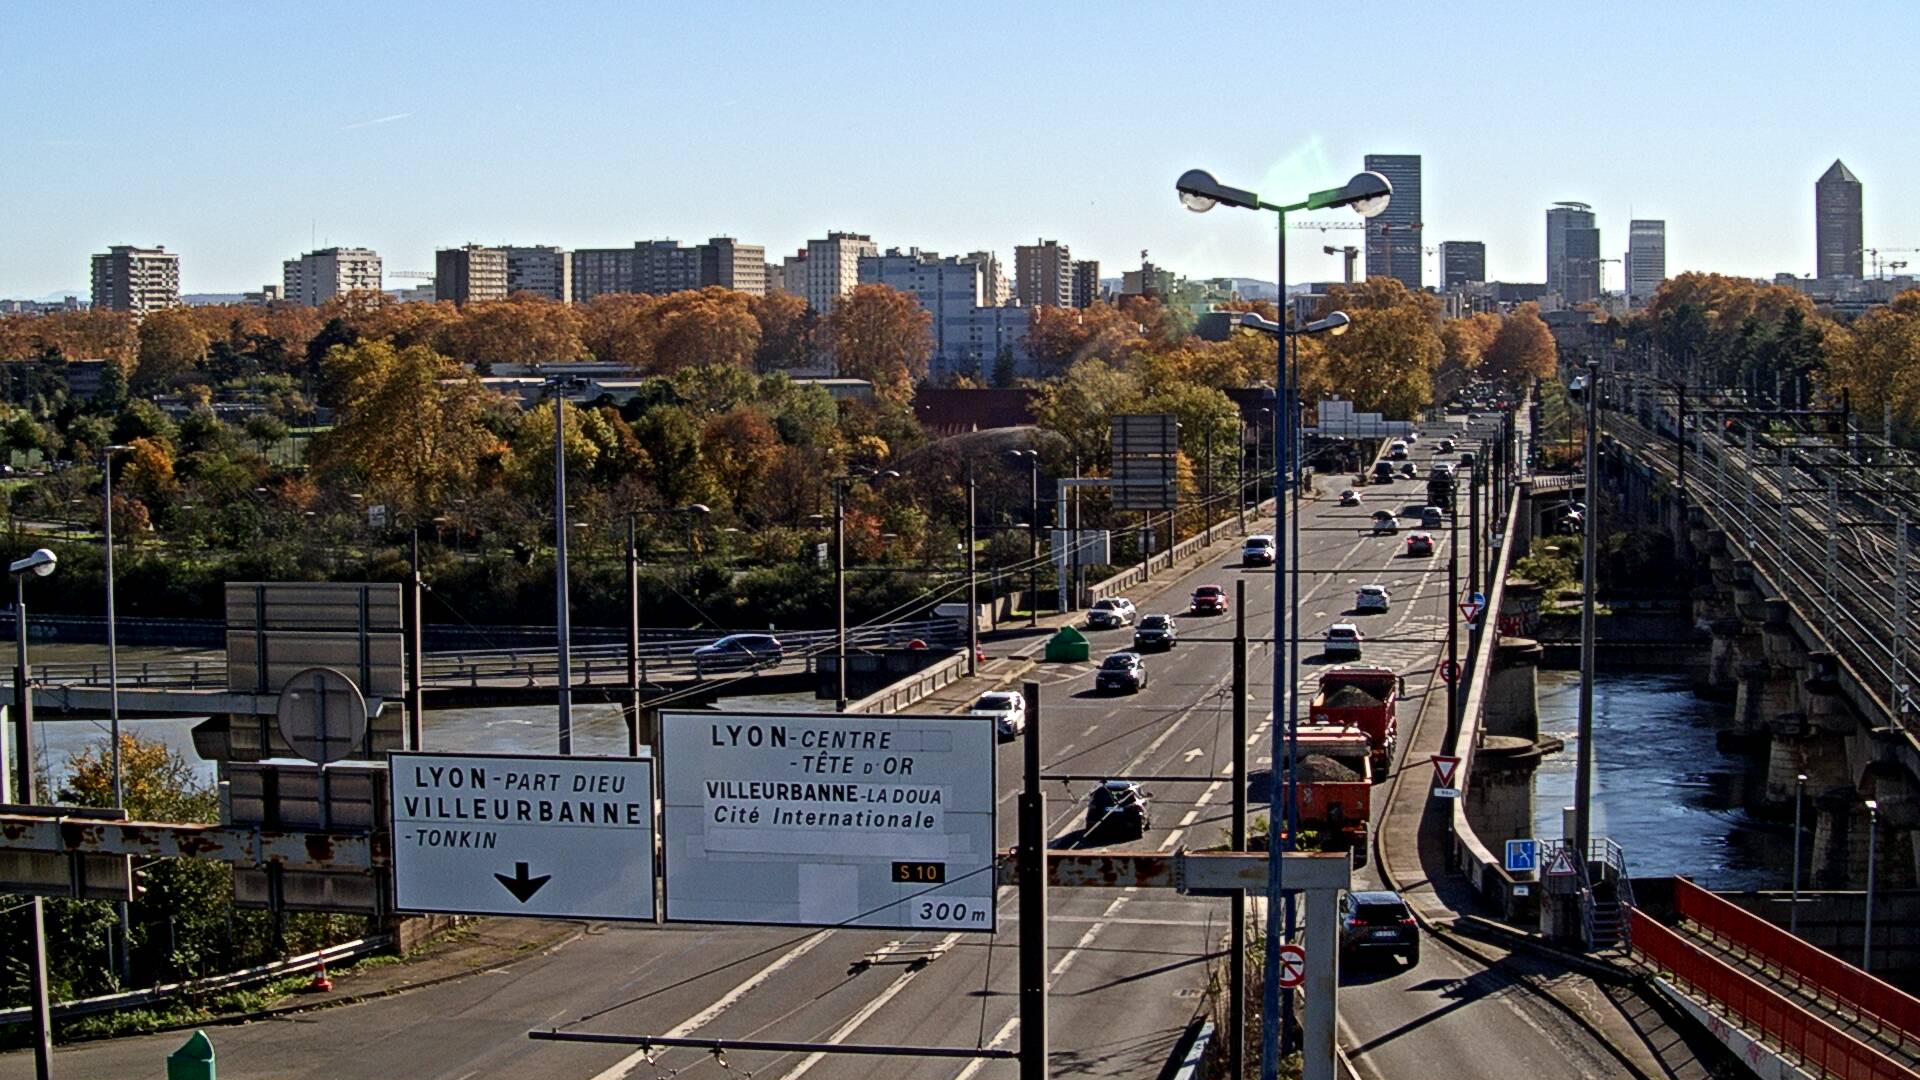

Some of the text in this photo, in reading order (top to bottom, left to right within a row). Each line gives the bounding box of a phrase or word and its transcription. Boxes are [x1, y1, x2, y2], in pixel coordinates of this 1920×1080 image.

[573, 775, 626, 793] DIEU
[893, 789, 942, 804] DOUA
[404, 797, 641, 825] VILLEURBANNE
[714, 805, 935, 828] Cité Internationale
